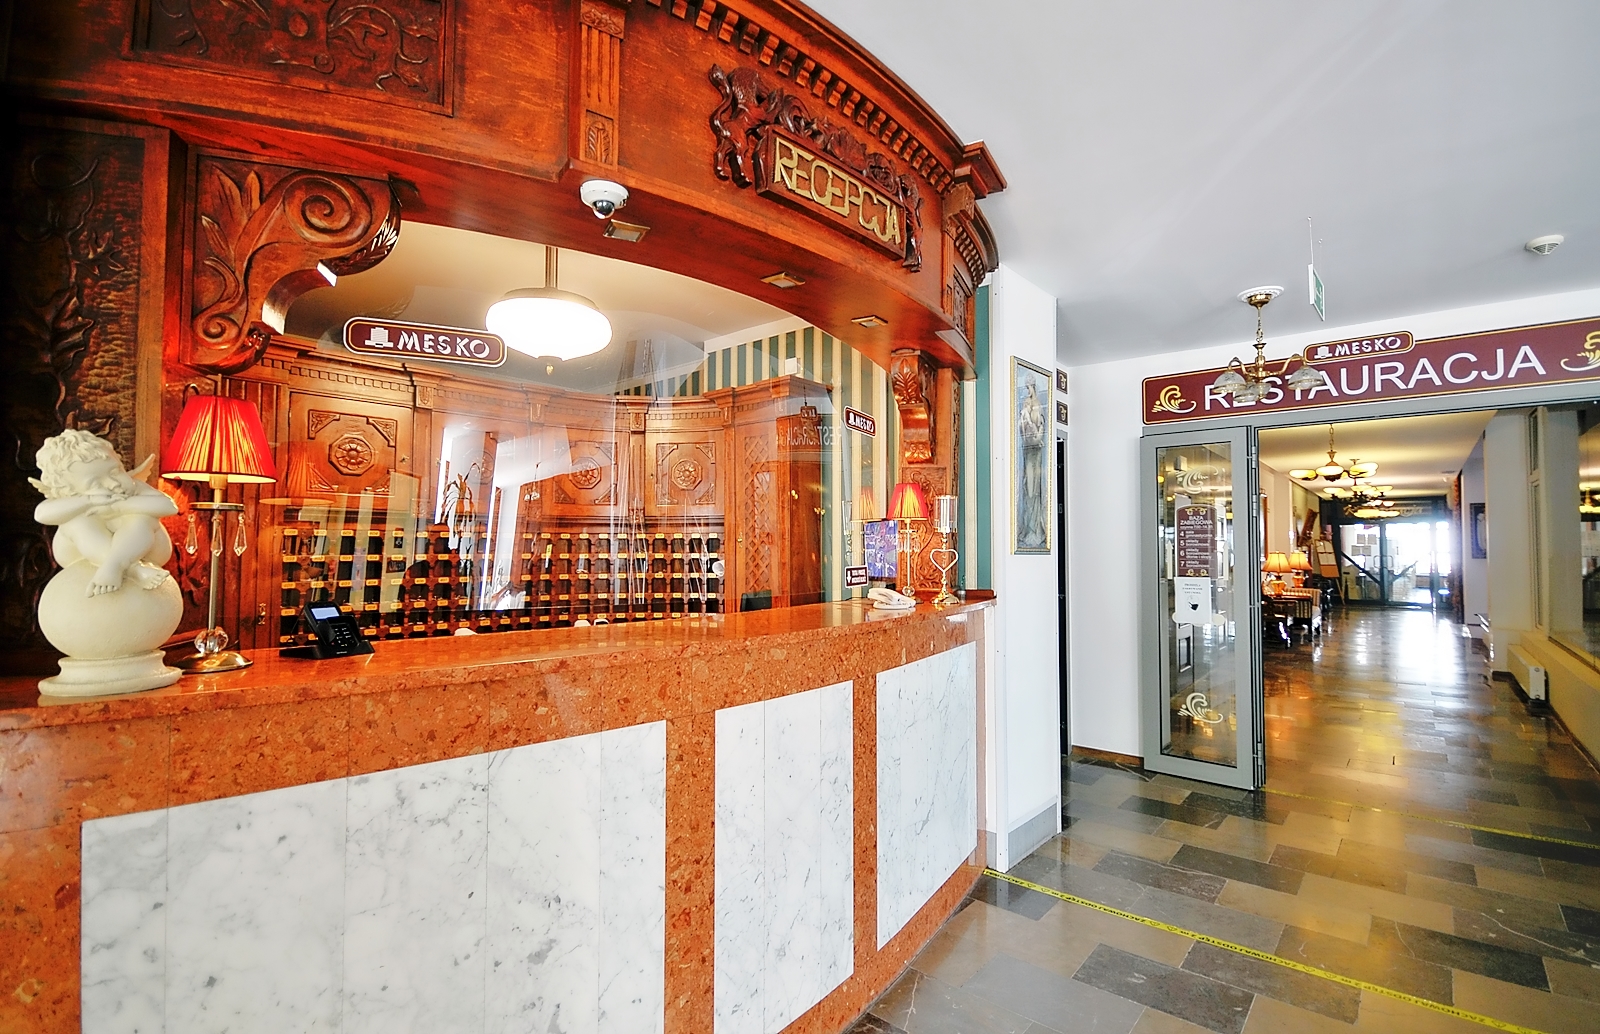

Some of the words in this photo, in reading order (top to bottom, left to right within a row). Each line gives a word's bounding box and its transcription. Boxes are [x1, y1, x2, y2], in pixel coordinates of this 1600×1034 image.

[774, 137, 900, 245] RECEPCJA
[397, 331, 490, 359] MESKO
[1334, 336, 1401, 356] MESKO
[1239, 946, 1298, 968] ZACHOWAJ
[1414, 999, 1486, 1023] ZACHOWAJ
